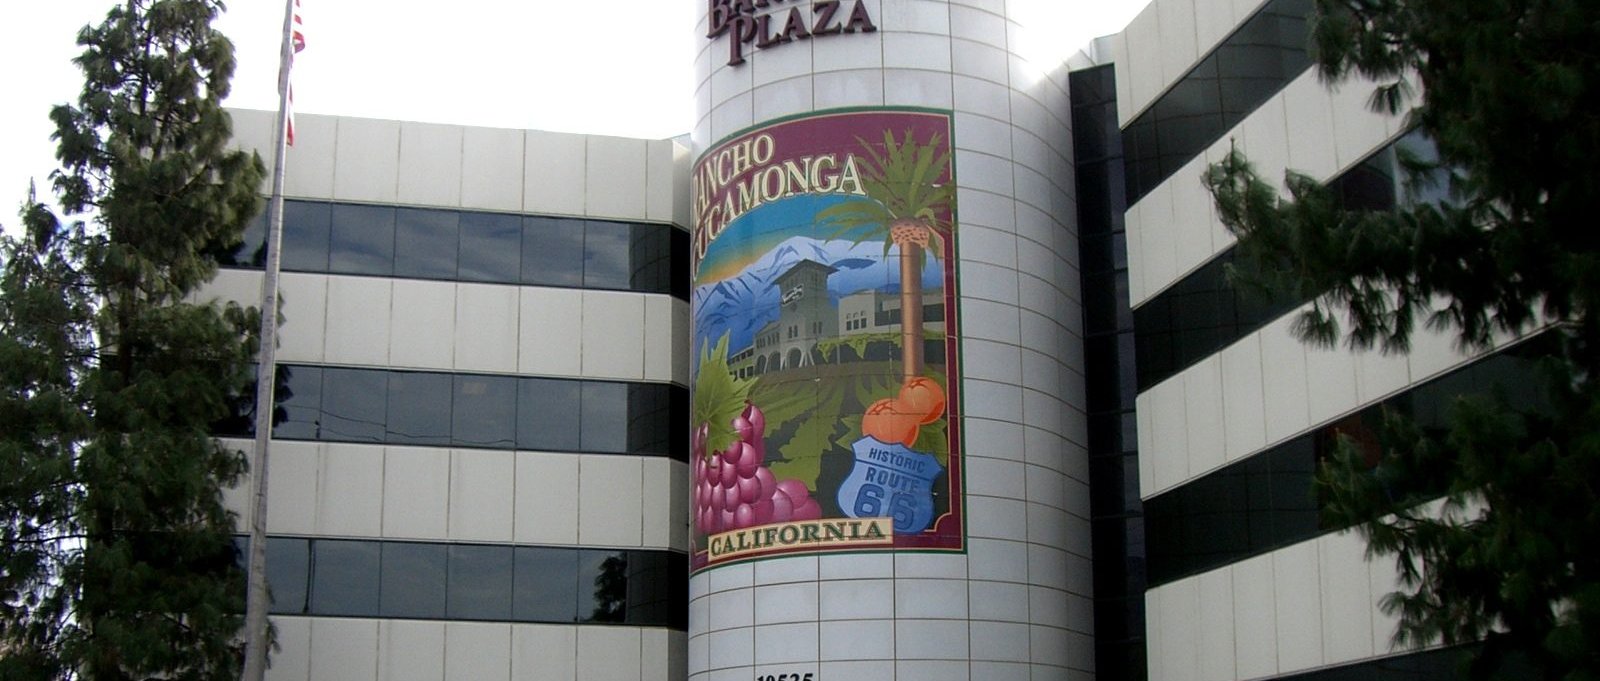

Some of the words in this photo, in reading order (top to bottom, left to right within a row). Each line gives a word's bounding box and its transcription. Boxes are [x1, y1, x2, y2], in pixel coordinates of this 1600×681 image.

[727, 0, 877, 66] PLAZA
[868, 447, 926, 474] HISTORIC
[864, 466, 920, 494] ROUTE
[853, 483, 917, 531] 66
[711, 521, 887, 556] CALIFORNIA
